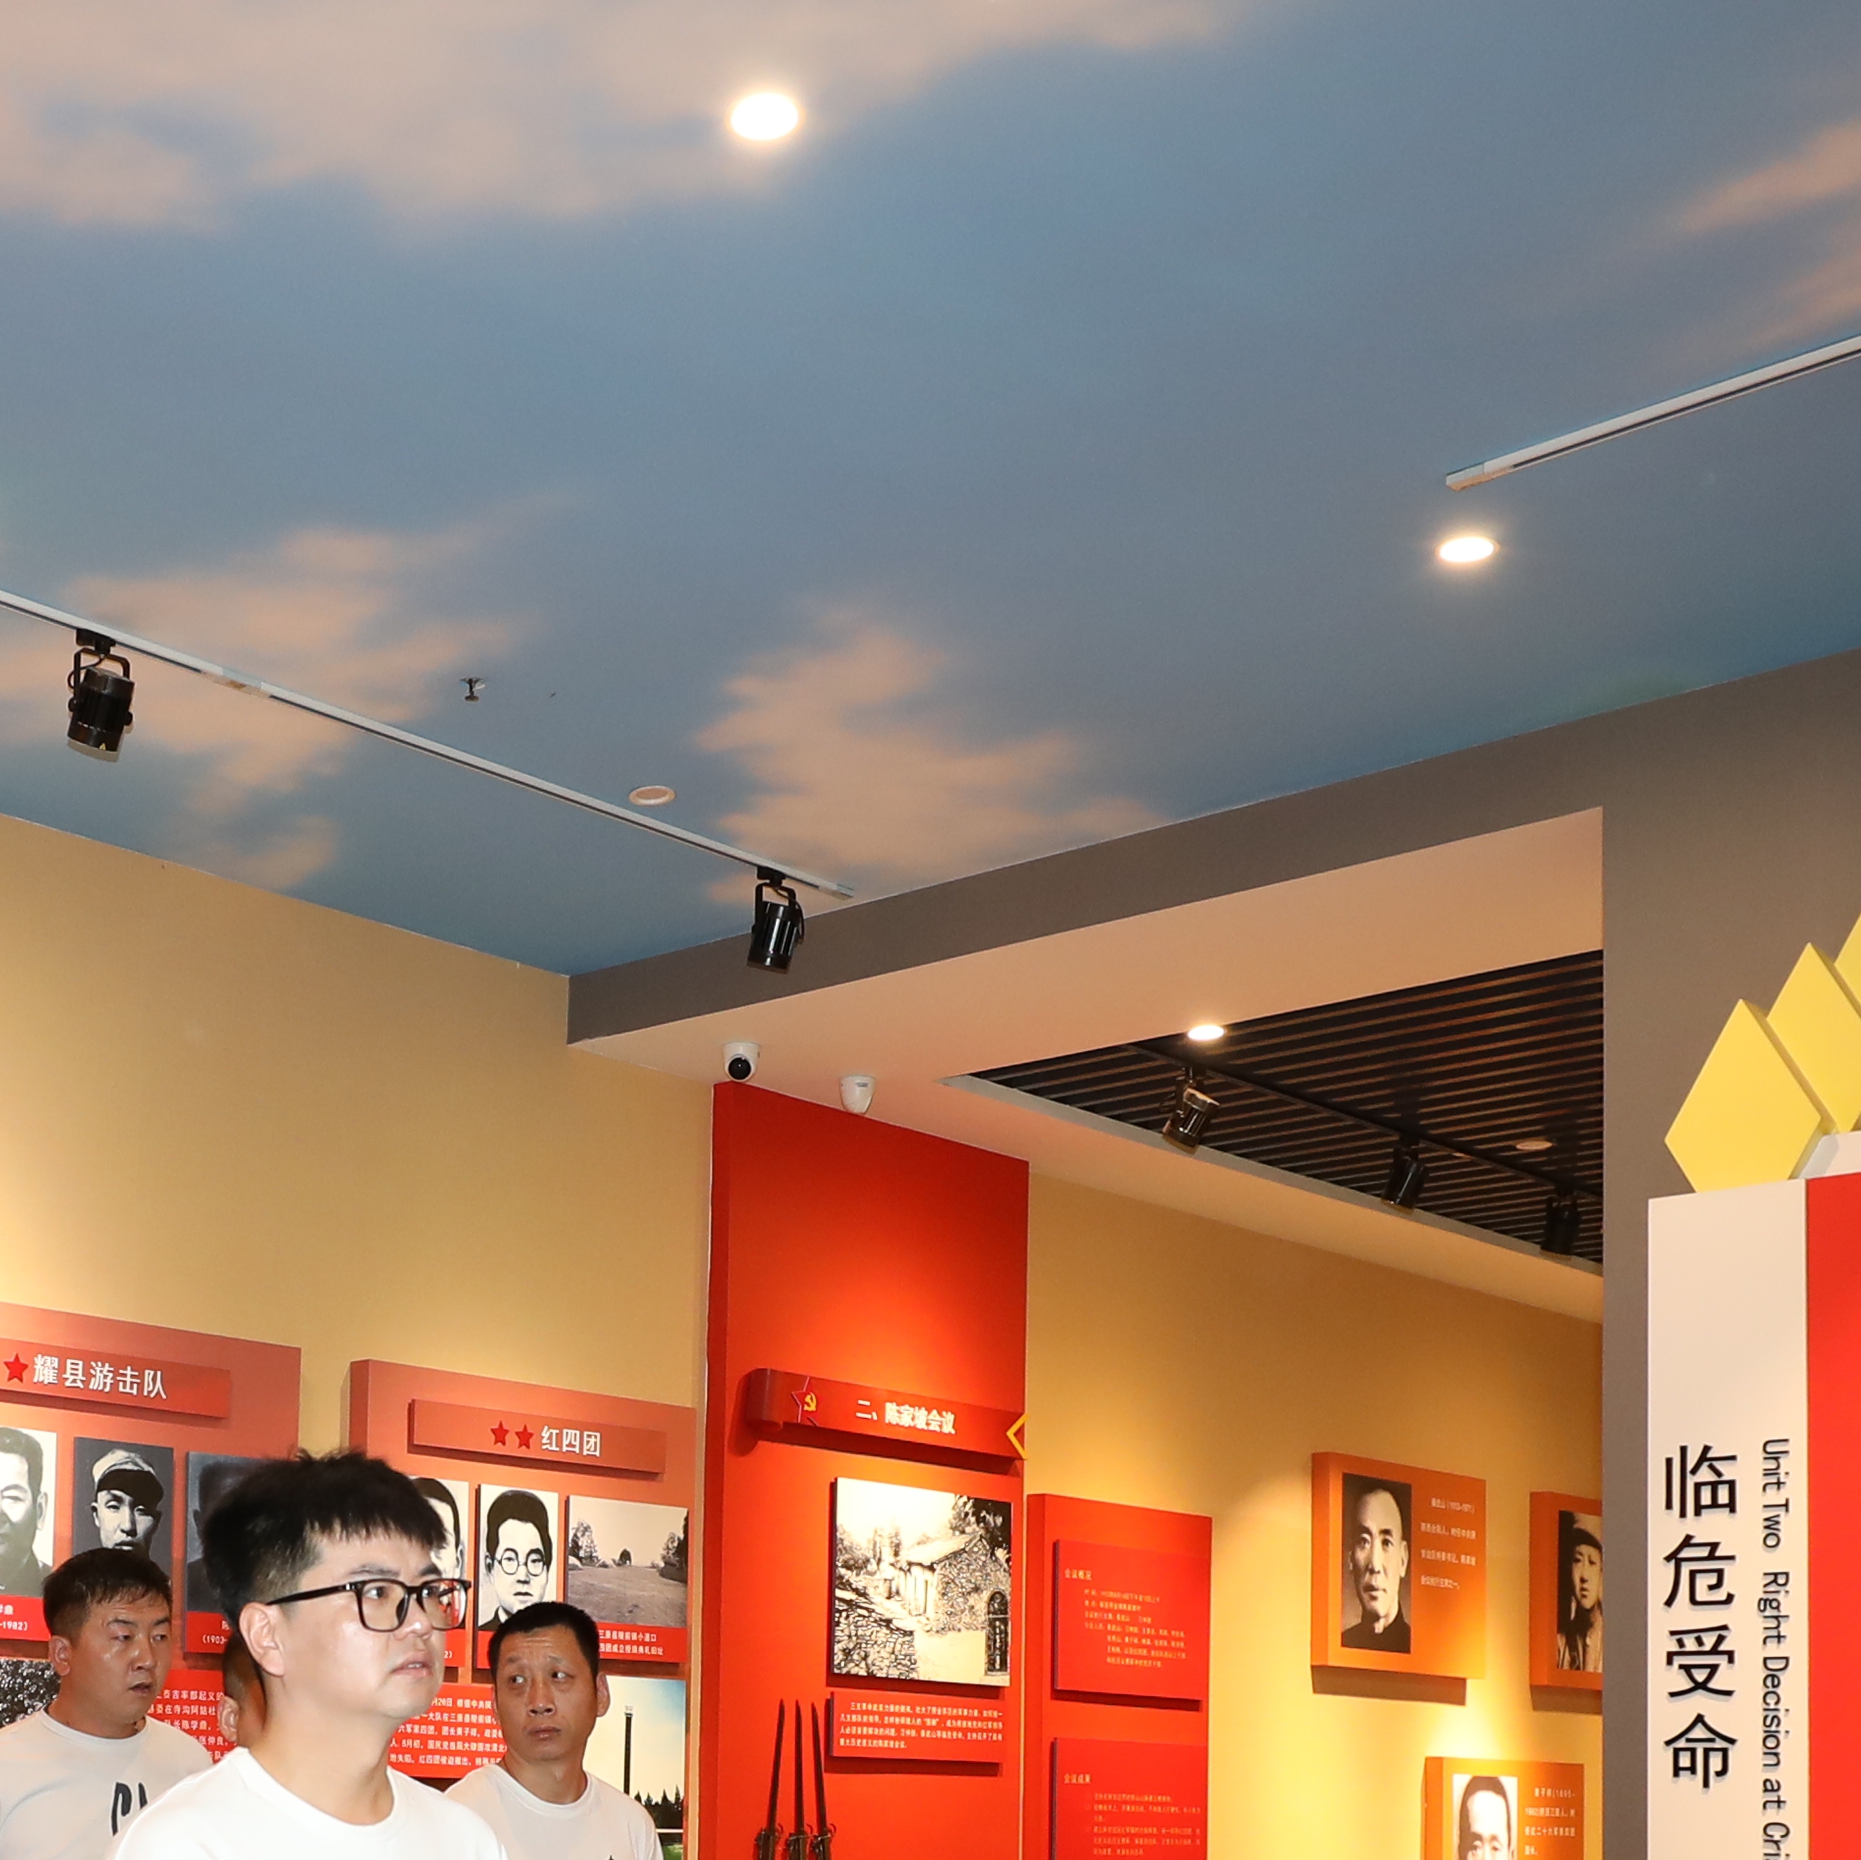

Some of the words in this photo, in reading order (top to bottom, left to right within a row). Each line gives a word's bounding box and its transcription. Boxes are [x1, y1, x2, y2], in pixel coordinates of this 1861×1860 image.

[32, 1353, 169, 1401] 耀县游击队
[540, 1425, 603, 1458] 红四团
[856, 1399, 956, 1435] 二、陈家坡会议
[1762, 1437, 1790, 1494] Unit
[1762, 1498, 1790, 1549] Two
[1662, 1443, 1738, 1790] 临危受命
[1756, 1570, 1790, 1646] Right
[1762, 1655, 1790, 1767] Decision
[1762, 1776, 1788, 1811] at
